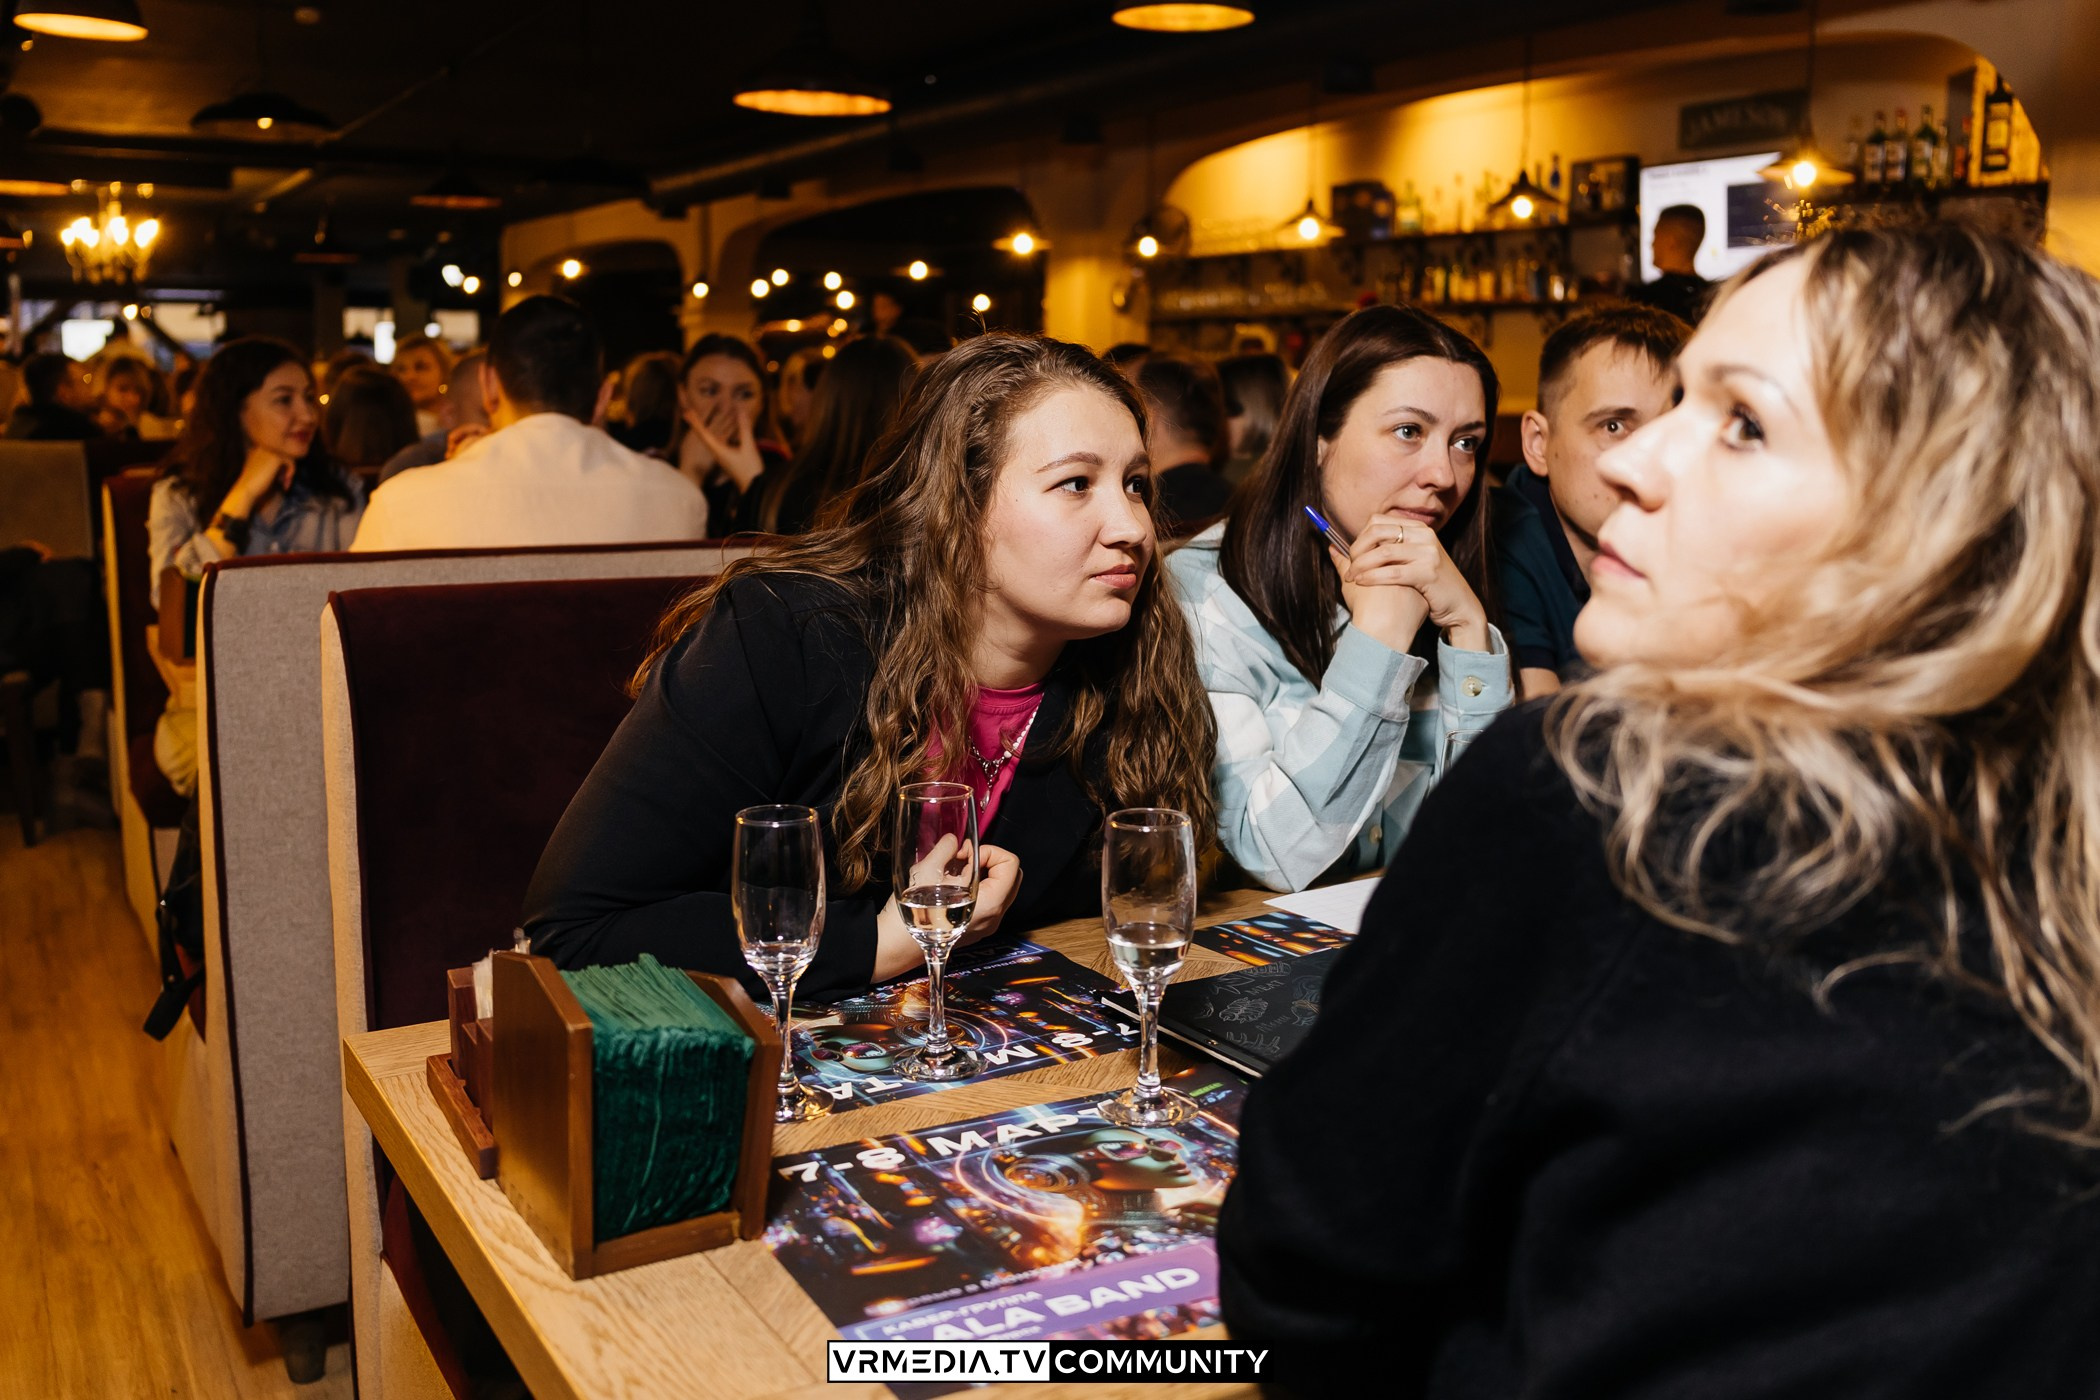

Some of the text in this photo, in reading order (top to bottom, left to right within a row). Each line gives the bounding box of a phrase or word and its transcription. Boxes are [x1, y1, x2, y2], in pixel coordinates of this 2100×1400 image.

[1245, 980, 1286, 995] MEAT
[811, 1022, 1140, 1100] 7-8 МТА
[778, 1097, 1114, 1183] 7-8 МАРТ
[1044, 1267, 1201, 1317] BAND
